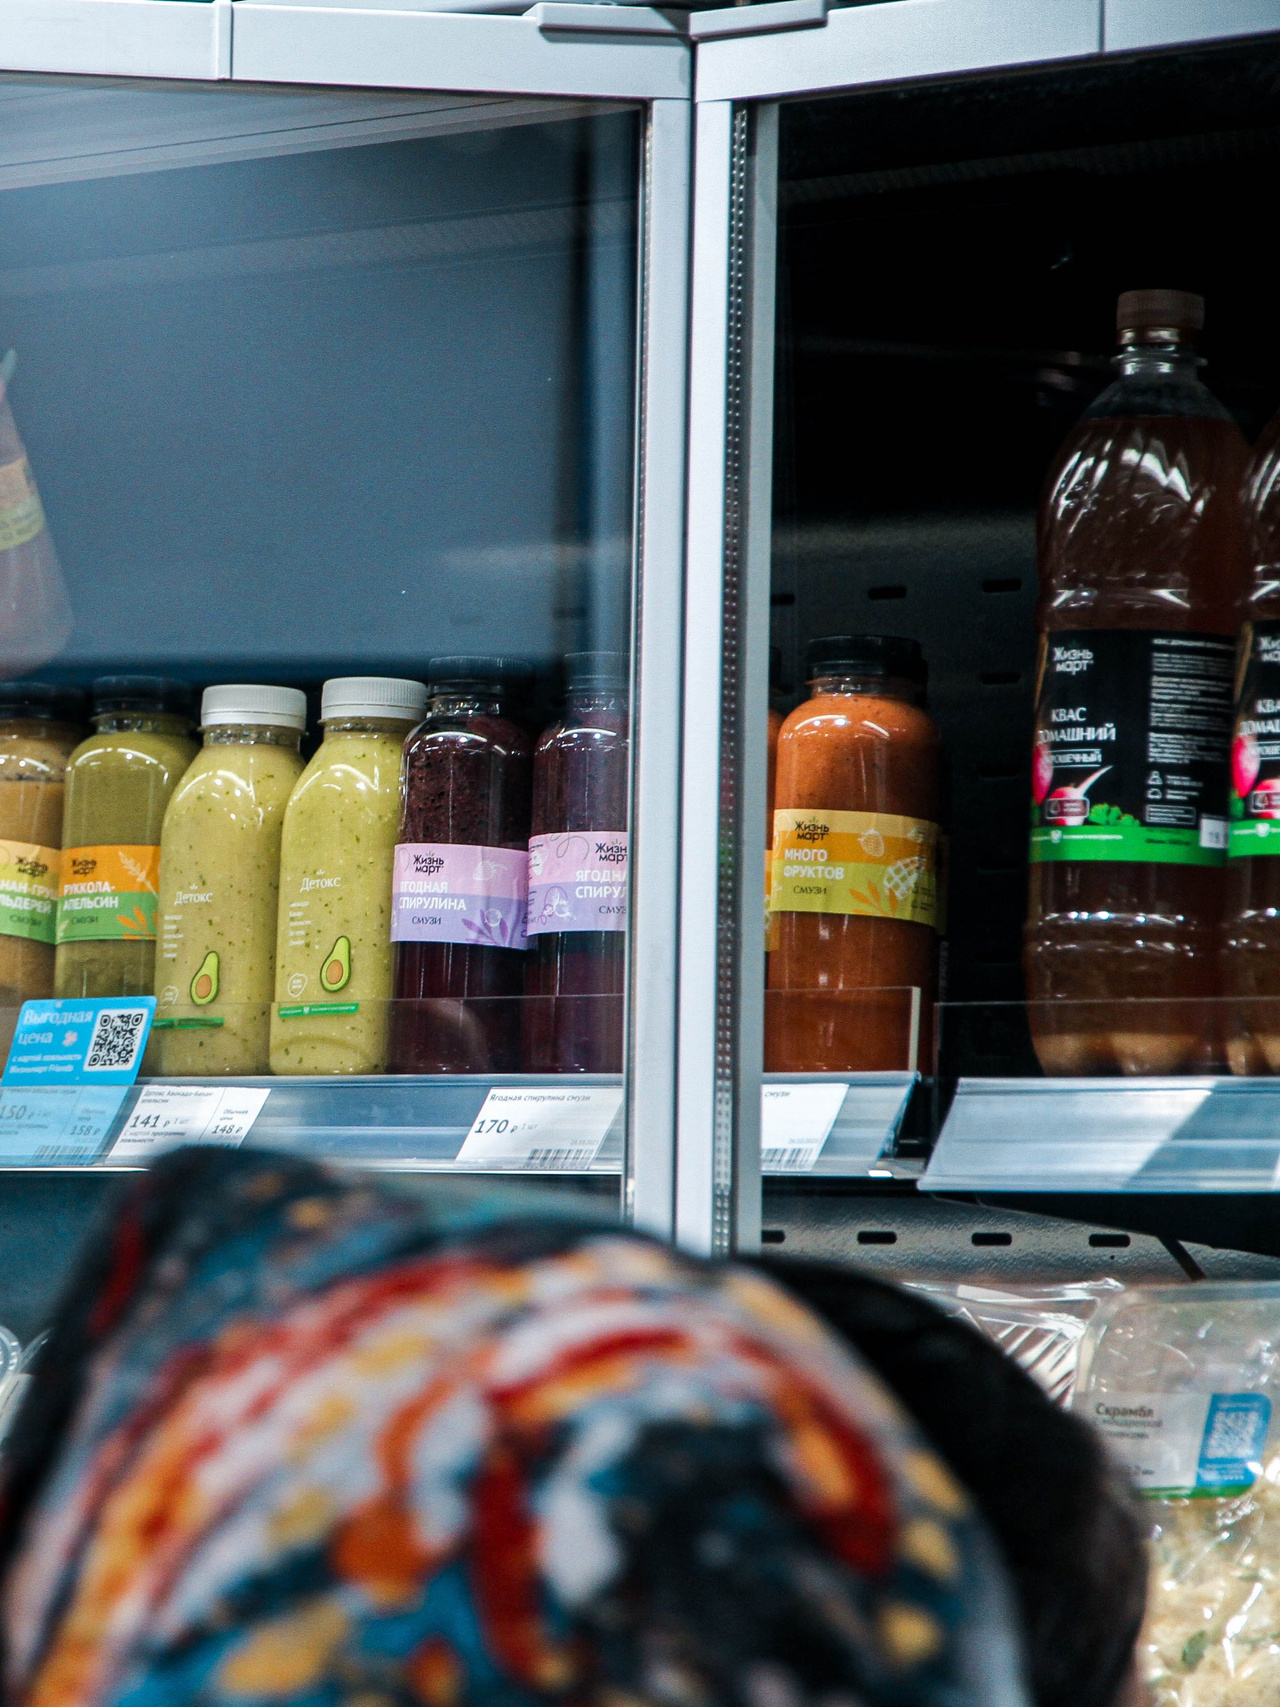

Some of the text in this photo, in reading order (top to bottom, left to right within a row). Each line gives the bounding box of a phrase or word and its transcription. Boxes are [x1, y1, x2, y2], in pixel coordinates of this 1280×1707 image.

[1051, 706, 1087, 722] КВАС
[795, 820, 829, 832] Жизнь
[797, 831, 826, 843] март
[413, 854, 445, 865] Жизнь
[784, 848, 828, 862] МНОГО
[415, 864, 441, 876] март
[783, 864, 845, 880] ФРУКТОВ
[300, 877, 342, 893] Детокс
[793, 885, 827, 895] СМУЗИ
[173, 890, 214, 906] Детокс
[411, 915, 442, 926] СМУЗИ
[23, 1009, 94, 1026] Выгодная
[18, 1031, 54, 1046] цена
[129, 1114, 161, 1128] 141
[474, 1118, 509, 1134] 170
[69, 1125, 93, 1136] 158
[211, 1124, 235, 1135] 148
[1095, 1402, 1155, 1419] Скрамбл
